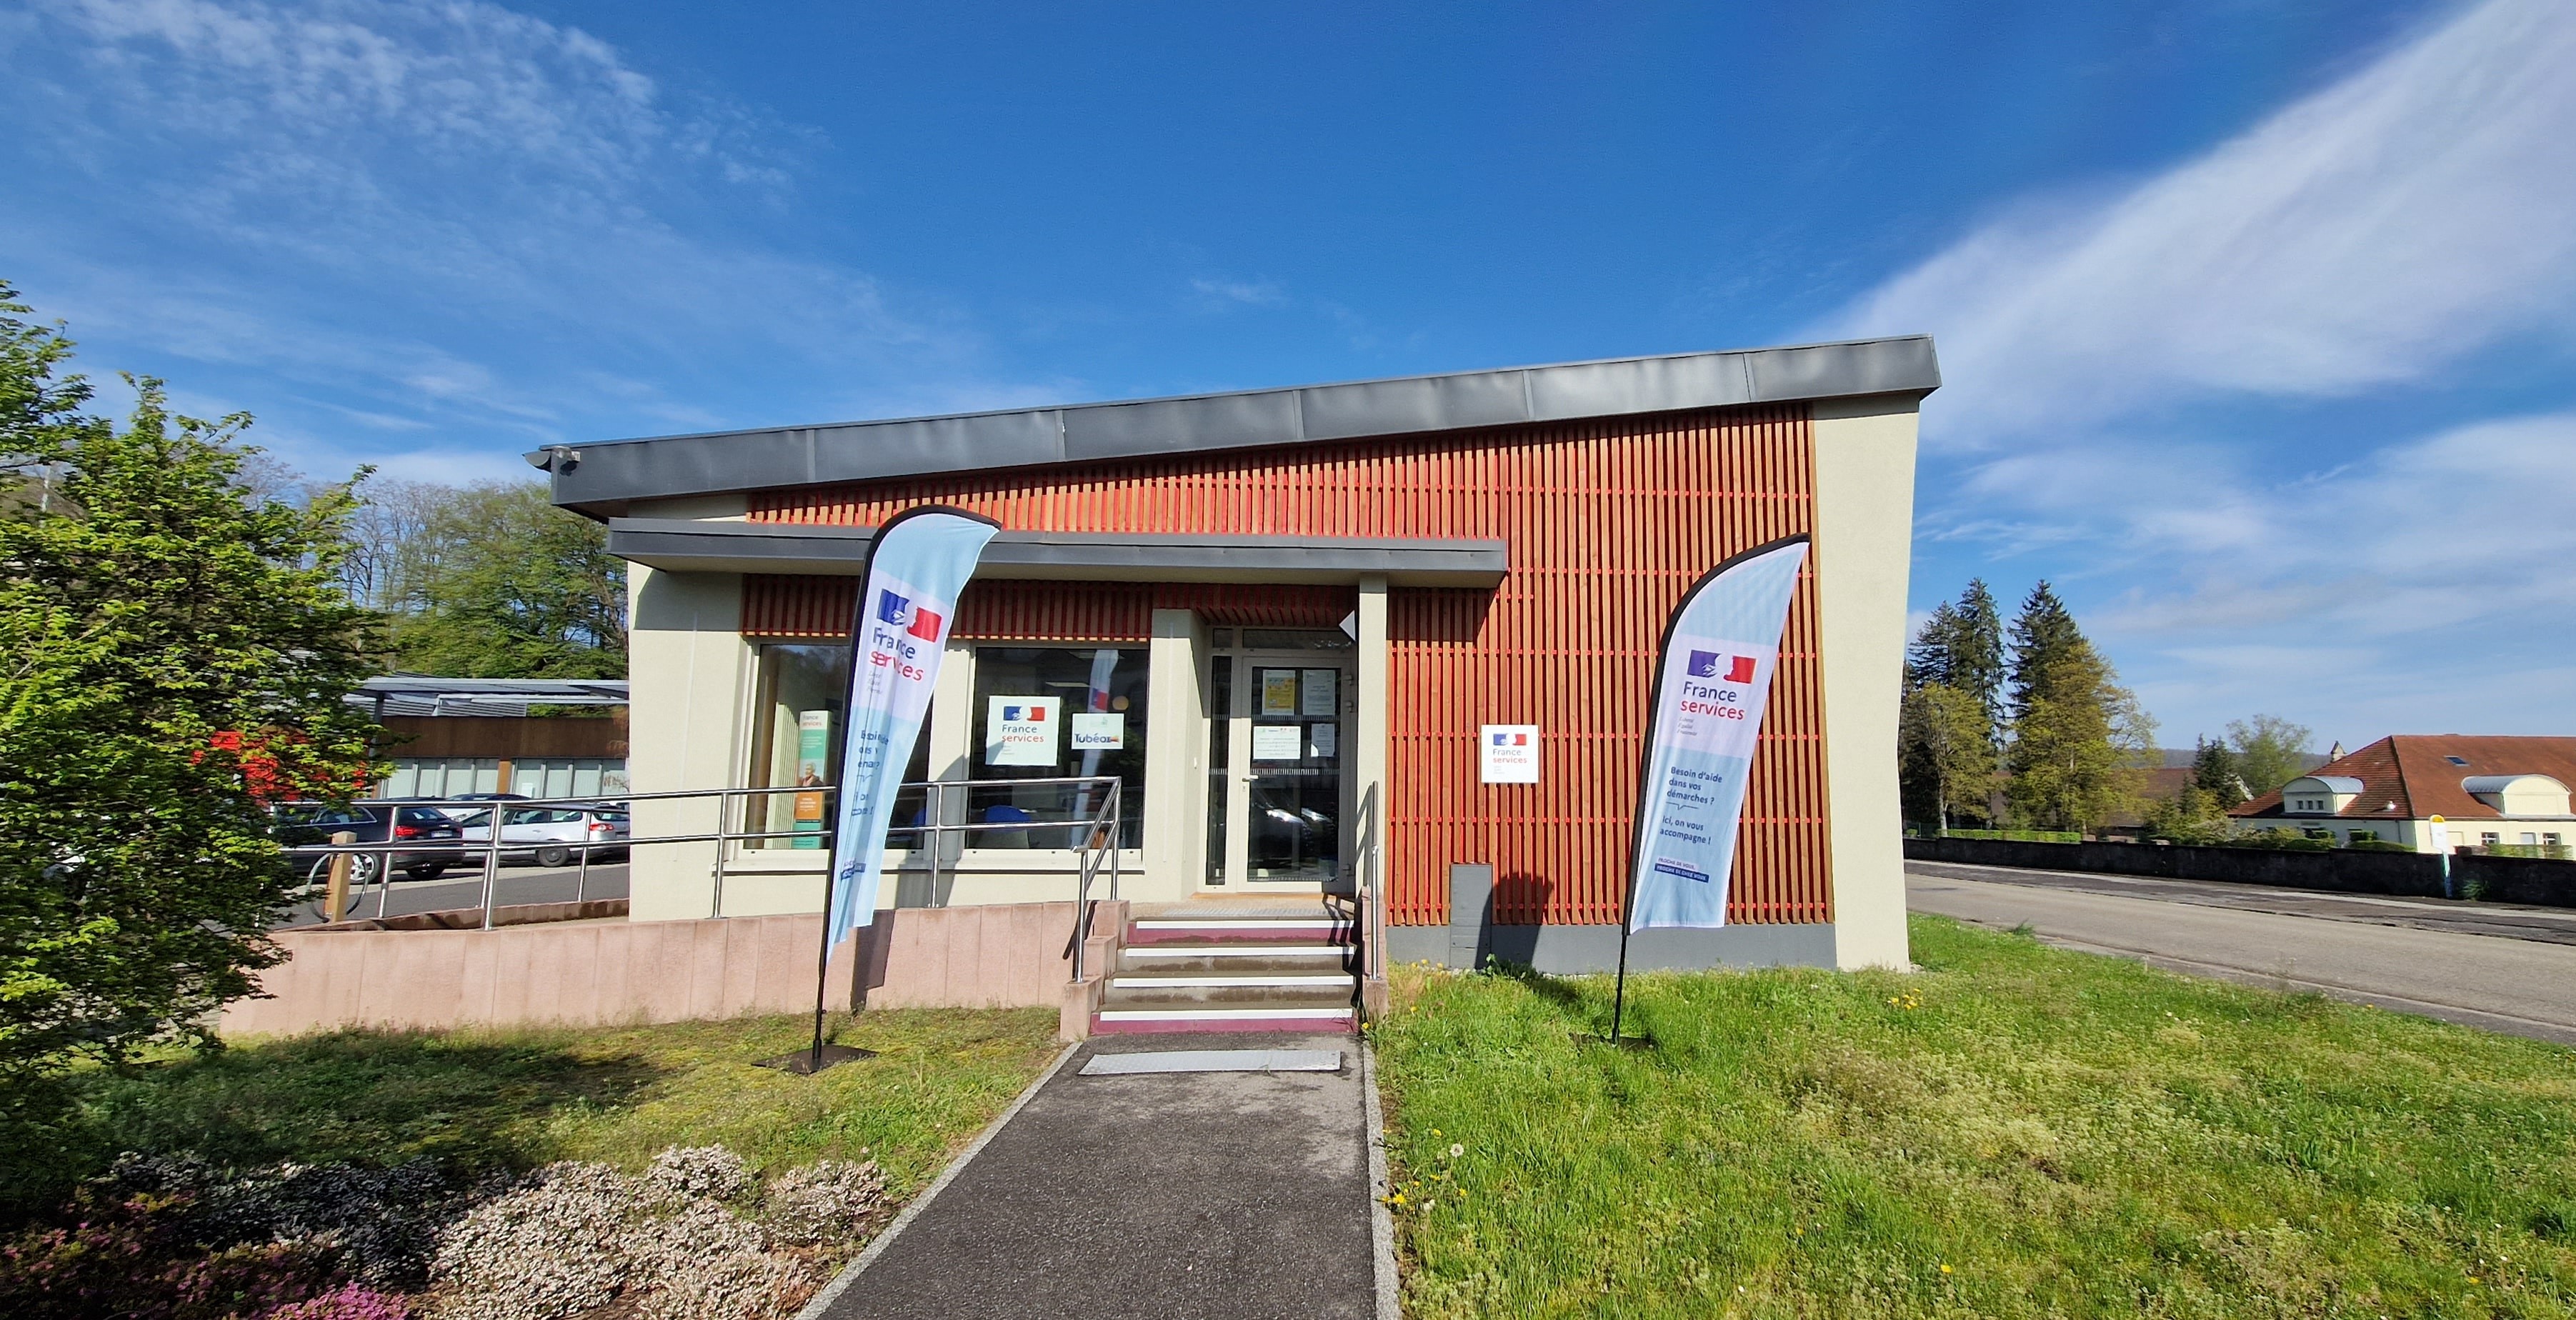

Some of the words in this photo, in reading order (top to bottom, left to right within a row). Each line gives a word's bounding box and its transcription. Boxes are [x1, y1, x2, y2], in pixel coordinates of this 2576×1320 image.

[1683, 681, 1737, 702] France
[1680, 700, 1744, 720] services
[1002, 724, 1037, 734] France
[1002, 734, 1044, 743] services
[1671, 766, 1696, 778] Besoin
[1698, 771, 1722, 783] d'aide
[1669, 777, 1687, 788] dans
[1689, 782, 1702, 791] vos
[1667, 789, 1708, 804] démarches
[1662, 815, 1673, 826] Ici,
[1686, 821, 1704, 831] vous
[1659, 828, 1707, 844] accompagne
